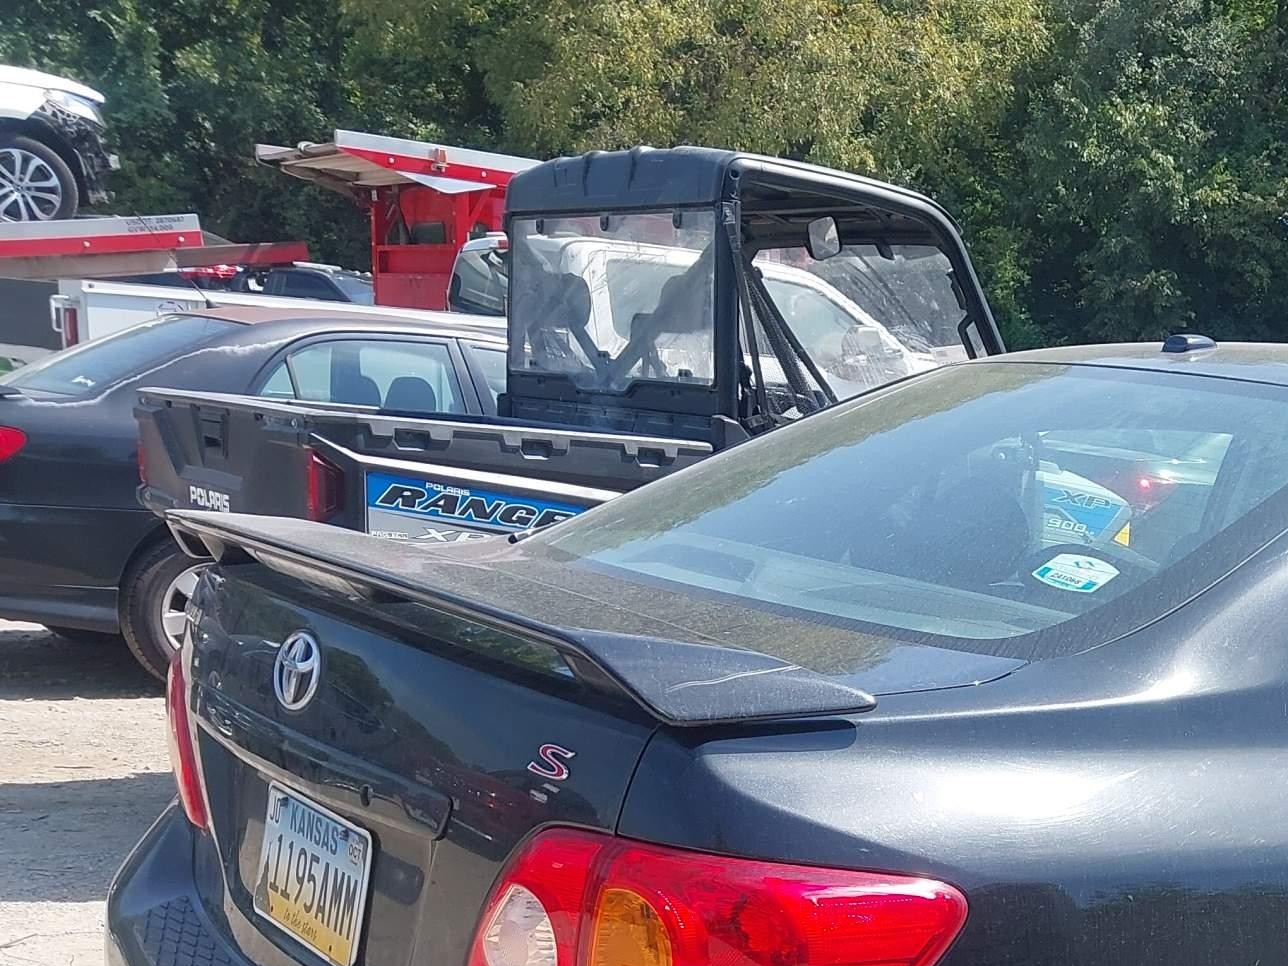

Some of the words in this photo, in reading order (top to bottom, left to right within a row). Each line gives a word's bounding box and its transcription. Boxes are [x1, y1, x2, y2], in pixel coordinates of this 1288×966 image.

[189, 485, 230, 513] POLARIS
[425, 481, 471, 496] POLARIS
[1051, 488, 1112, 509] XP
[1047, 518, 1087, 532] 900
[526, 743, 576, 781] S
[289, 802, 340, 856] KANSAS
[268, 833, 359, 941] 1195AMM
[283, 907, 290, 919] to
[290, 912, 302, 930] the
[300, 920, 318, 942] stars
